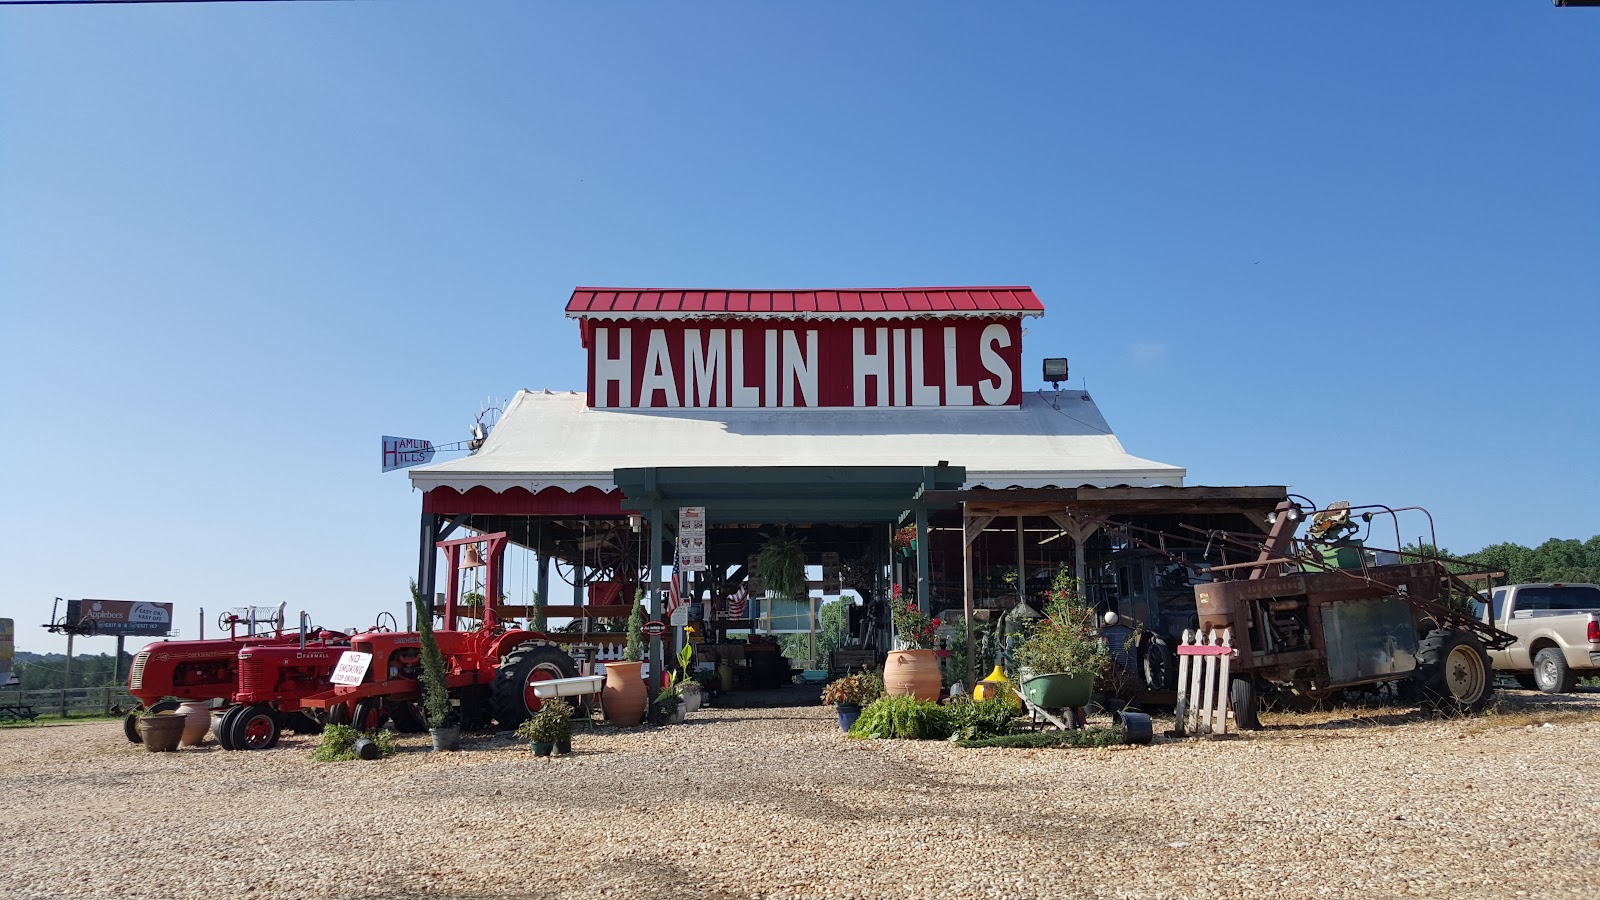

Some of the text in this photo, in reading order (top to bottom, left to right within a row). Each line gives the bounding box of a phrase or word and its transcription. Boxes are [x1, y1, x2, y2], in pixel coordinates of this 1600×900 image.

[595, 324, 1012, 407] HAMLIN HILLS
[87, 608, 123, 619] Applebee's
[348, 653, 360, 663] NO
[338, 663, 365, 675] SMOKING
[334, 673, 361, 683] STOP ENGINE
